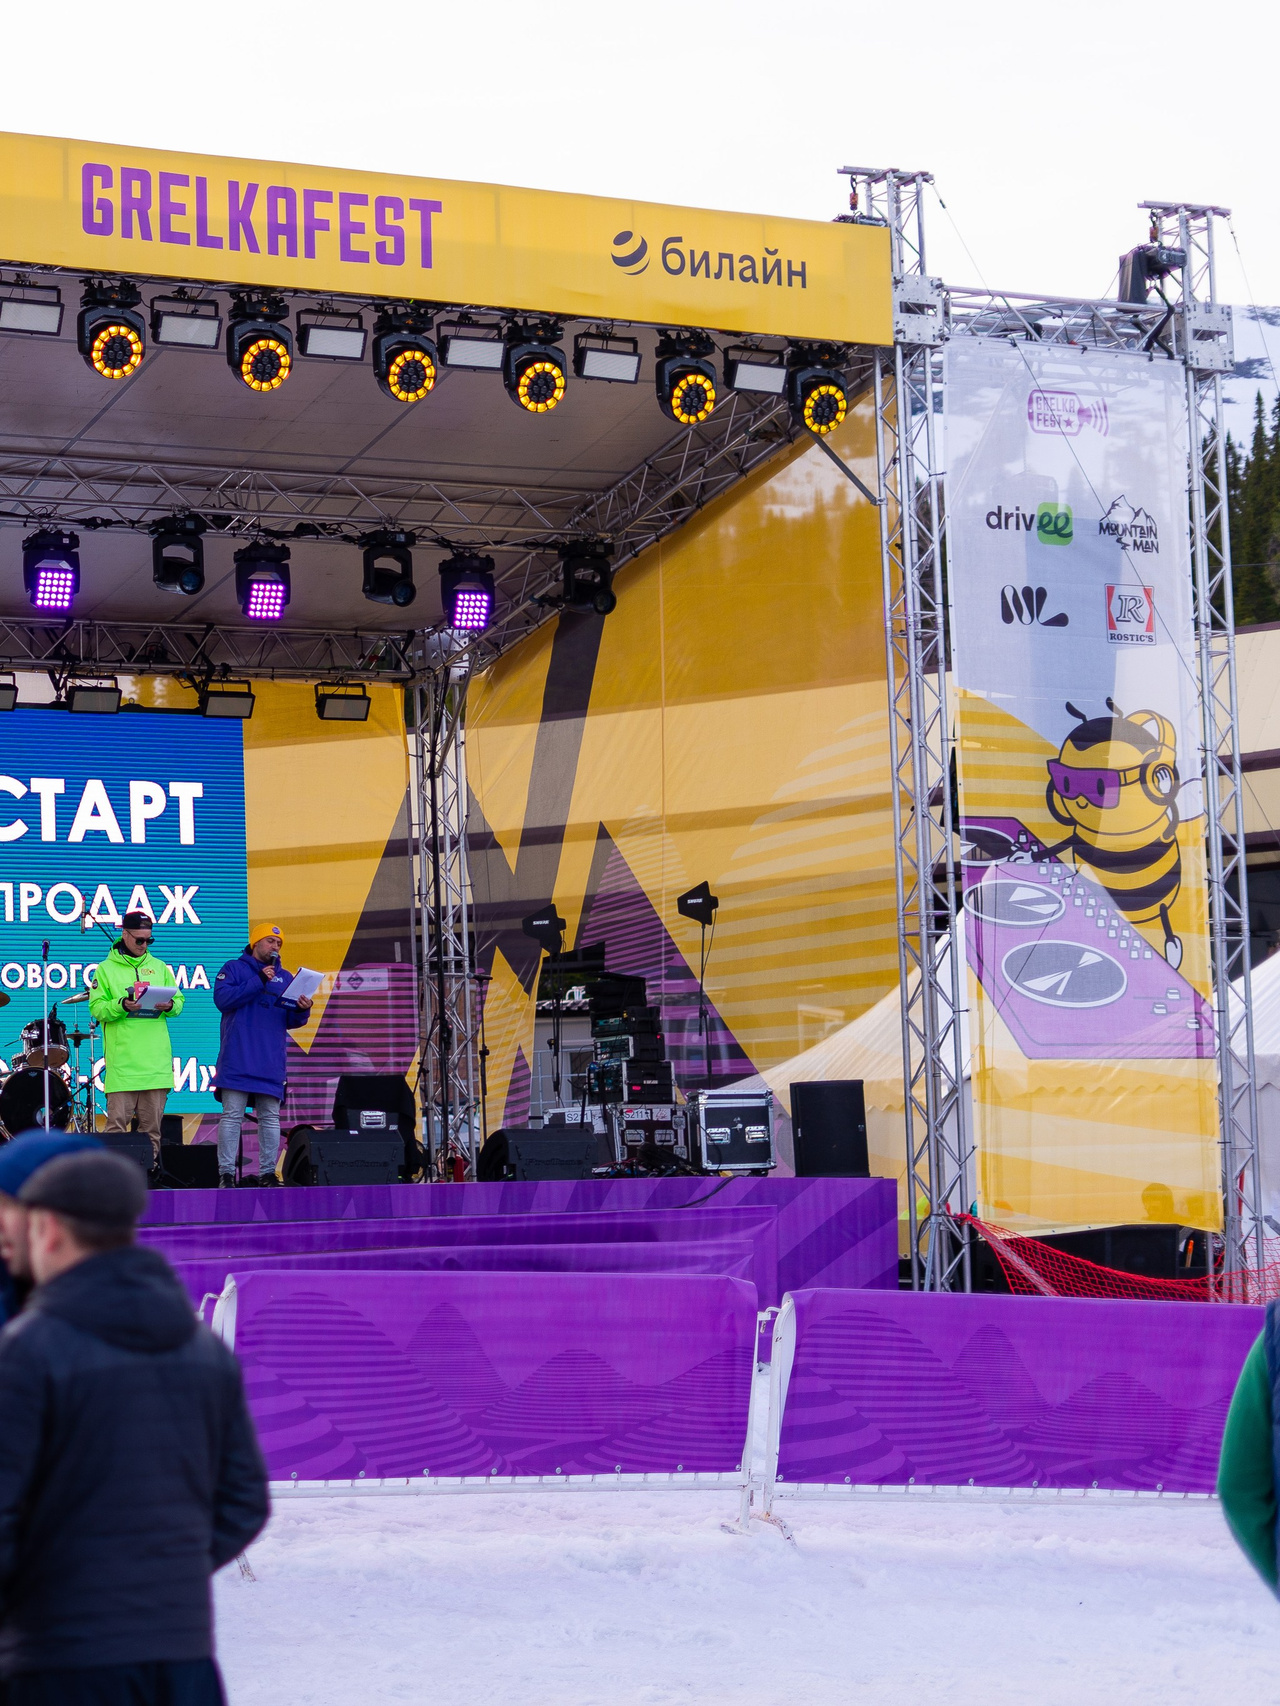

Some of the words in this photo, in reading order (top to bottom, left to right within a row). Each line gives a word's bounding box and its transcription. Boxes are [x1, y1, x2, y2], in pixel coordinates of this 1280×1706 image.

[81, 162, 443, 269] GRELKAFEST
[661, 236, 807, 289] билайн
[1035, 396, 1075, 413] GRELKA
[1036, 413, 1063, 428] FEST
[985, 505, 1073, 538] drivee
[1098, 521, 1158, 539] MOUNTAIN
[1133, 539, 1160, 554] MAN
[1109, 632, 1154, 643] ROSTIC'S
[567, 1113, 589, 1122] S21
